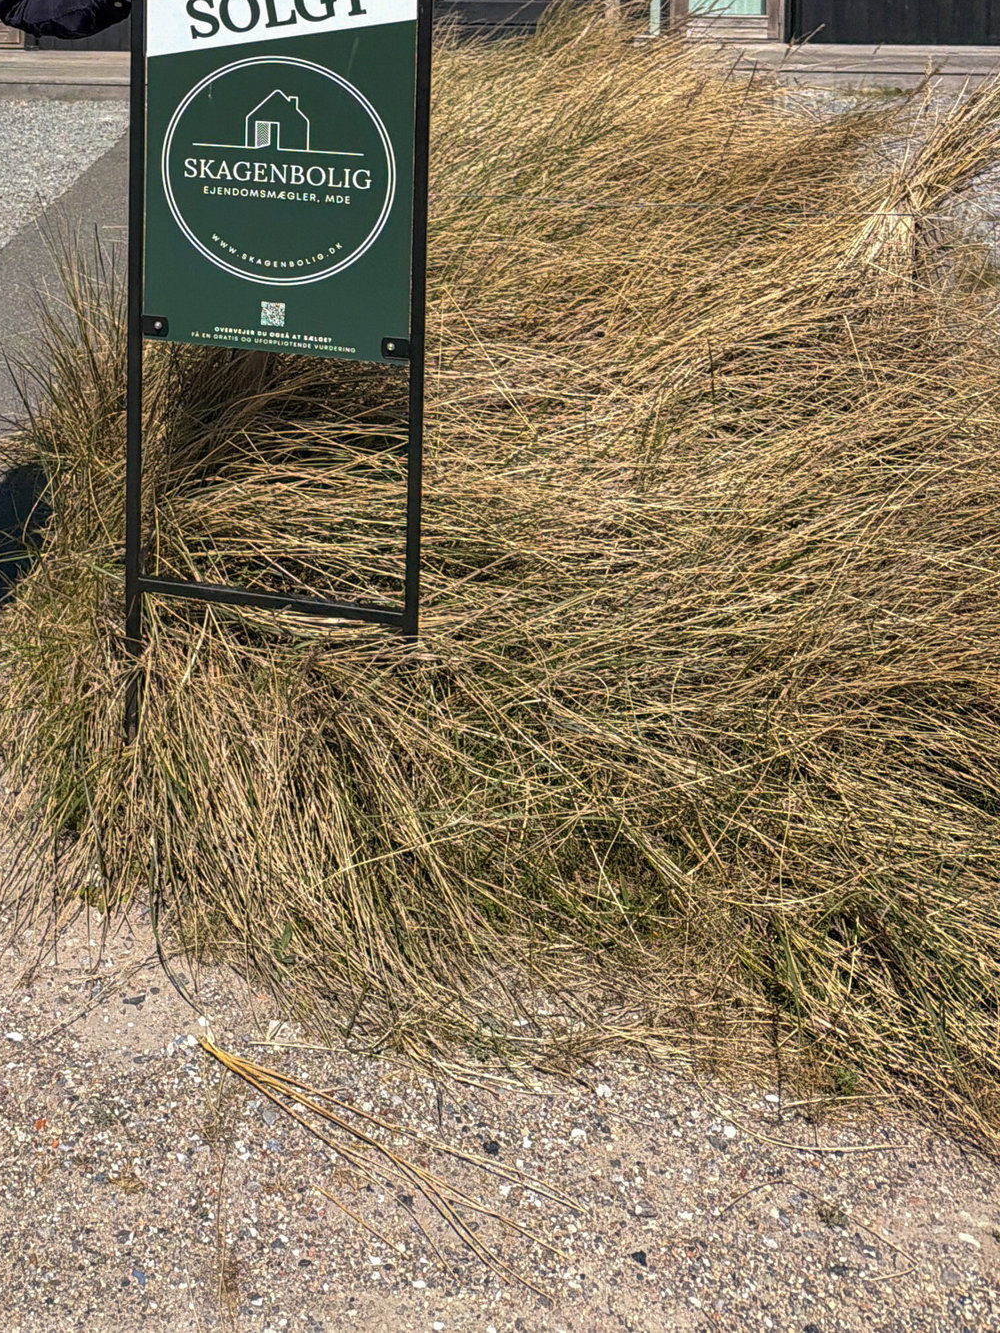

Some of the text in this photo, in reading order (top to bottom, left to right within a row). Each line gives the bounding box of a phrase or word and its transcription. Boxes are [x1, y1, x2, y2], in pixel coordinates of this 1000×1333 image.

[184, 158, 372, 190] SKAGENBOLIG
[203, 185, 351, 204] EJENDOMSMÆGLER, MDE
[211, 233, 343, 268] WWW.SKAGENBOLIG.DK
[214, 326, 255, 336] OVERVEJER
